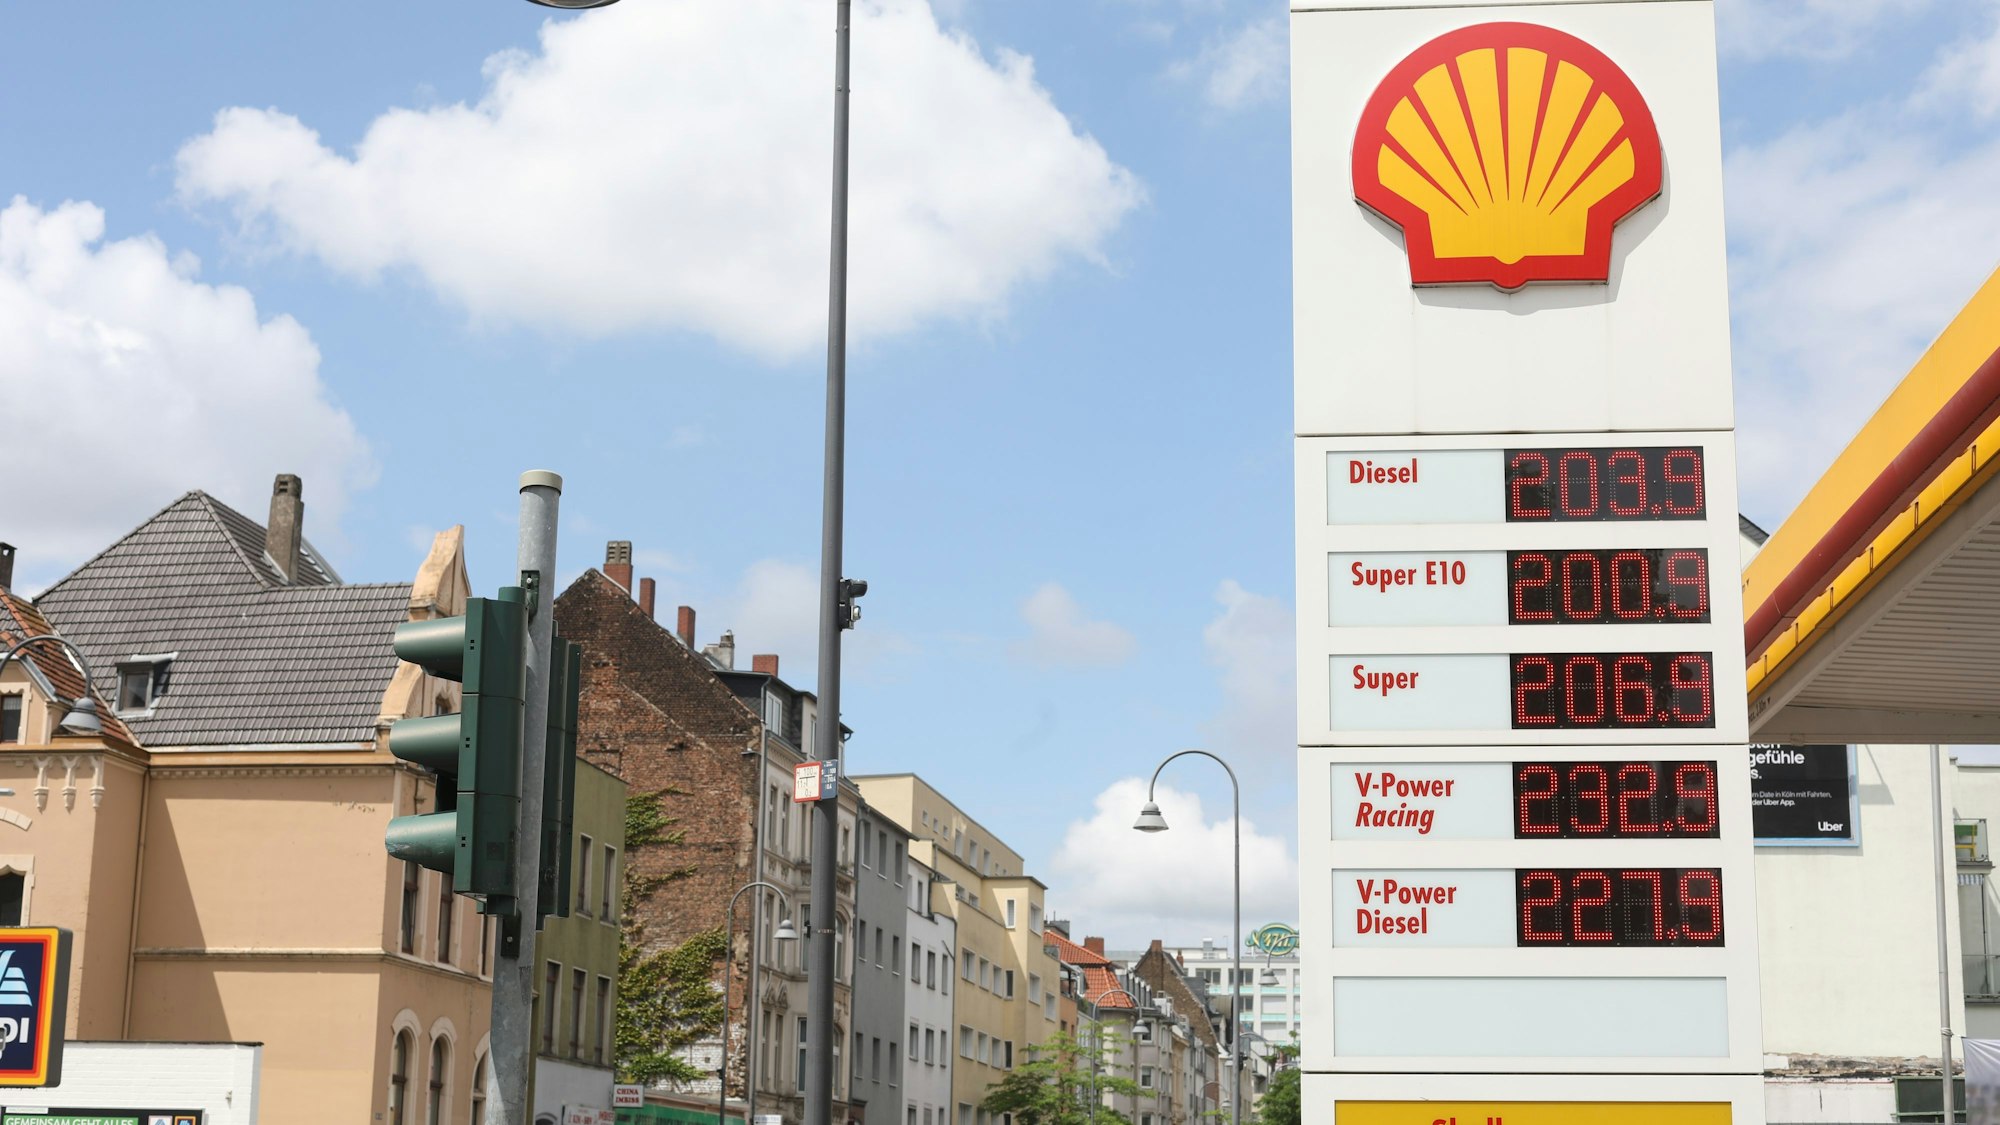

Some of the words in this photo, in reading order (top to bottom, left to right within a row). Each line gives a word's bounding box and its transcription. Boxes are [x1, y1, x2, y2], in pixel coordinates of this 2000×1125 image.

[1350, 459, 1418, 484] Diesel
[1511, 450, 1702, 517] 203.9
[1351, 561, 1417, 593] Super
[1426, 560, 1466, 585] E10
[1513, 551, 1707, 620] 200.9
[1353, 664, 1419, 697] Super
[1516, 655, 1712, 724] 206.9
[1355, 772, 1454, 797] V-Power
[1519, 763, 1717, 834] 232.9
[1782, 790, 1795, 798] Köln
[1355, 802, 1435, 835] Racing
[1780, 799, 1795, 807] App.
[1817, 821, 1844, 832] Uber
[1357, 879, 1457, 904] V-Power
[1522, 870, 1721, 941] 227.9
[1357, 907, 1427, 935] Diesel
